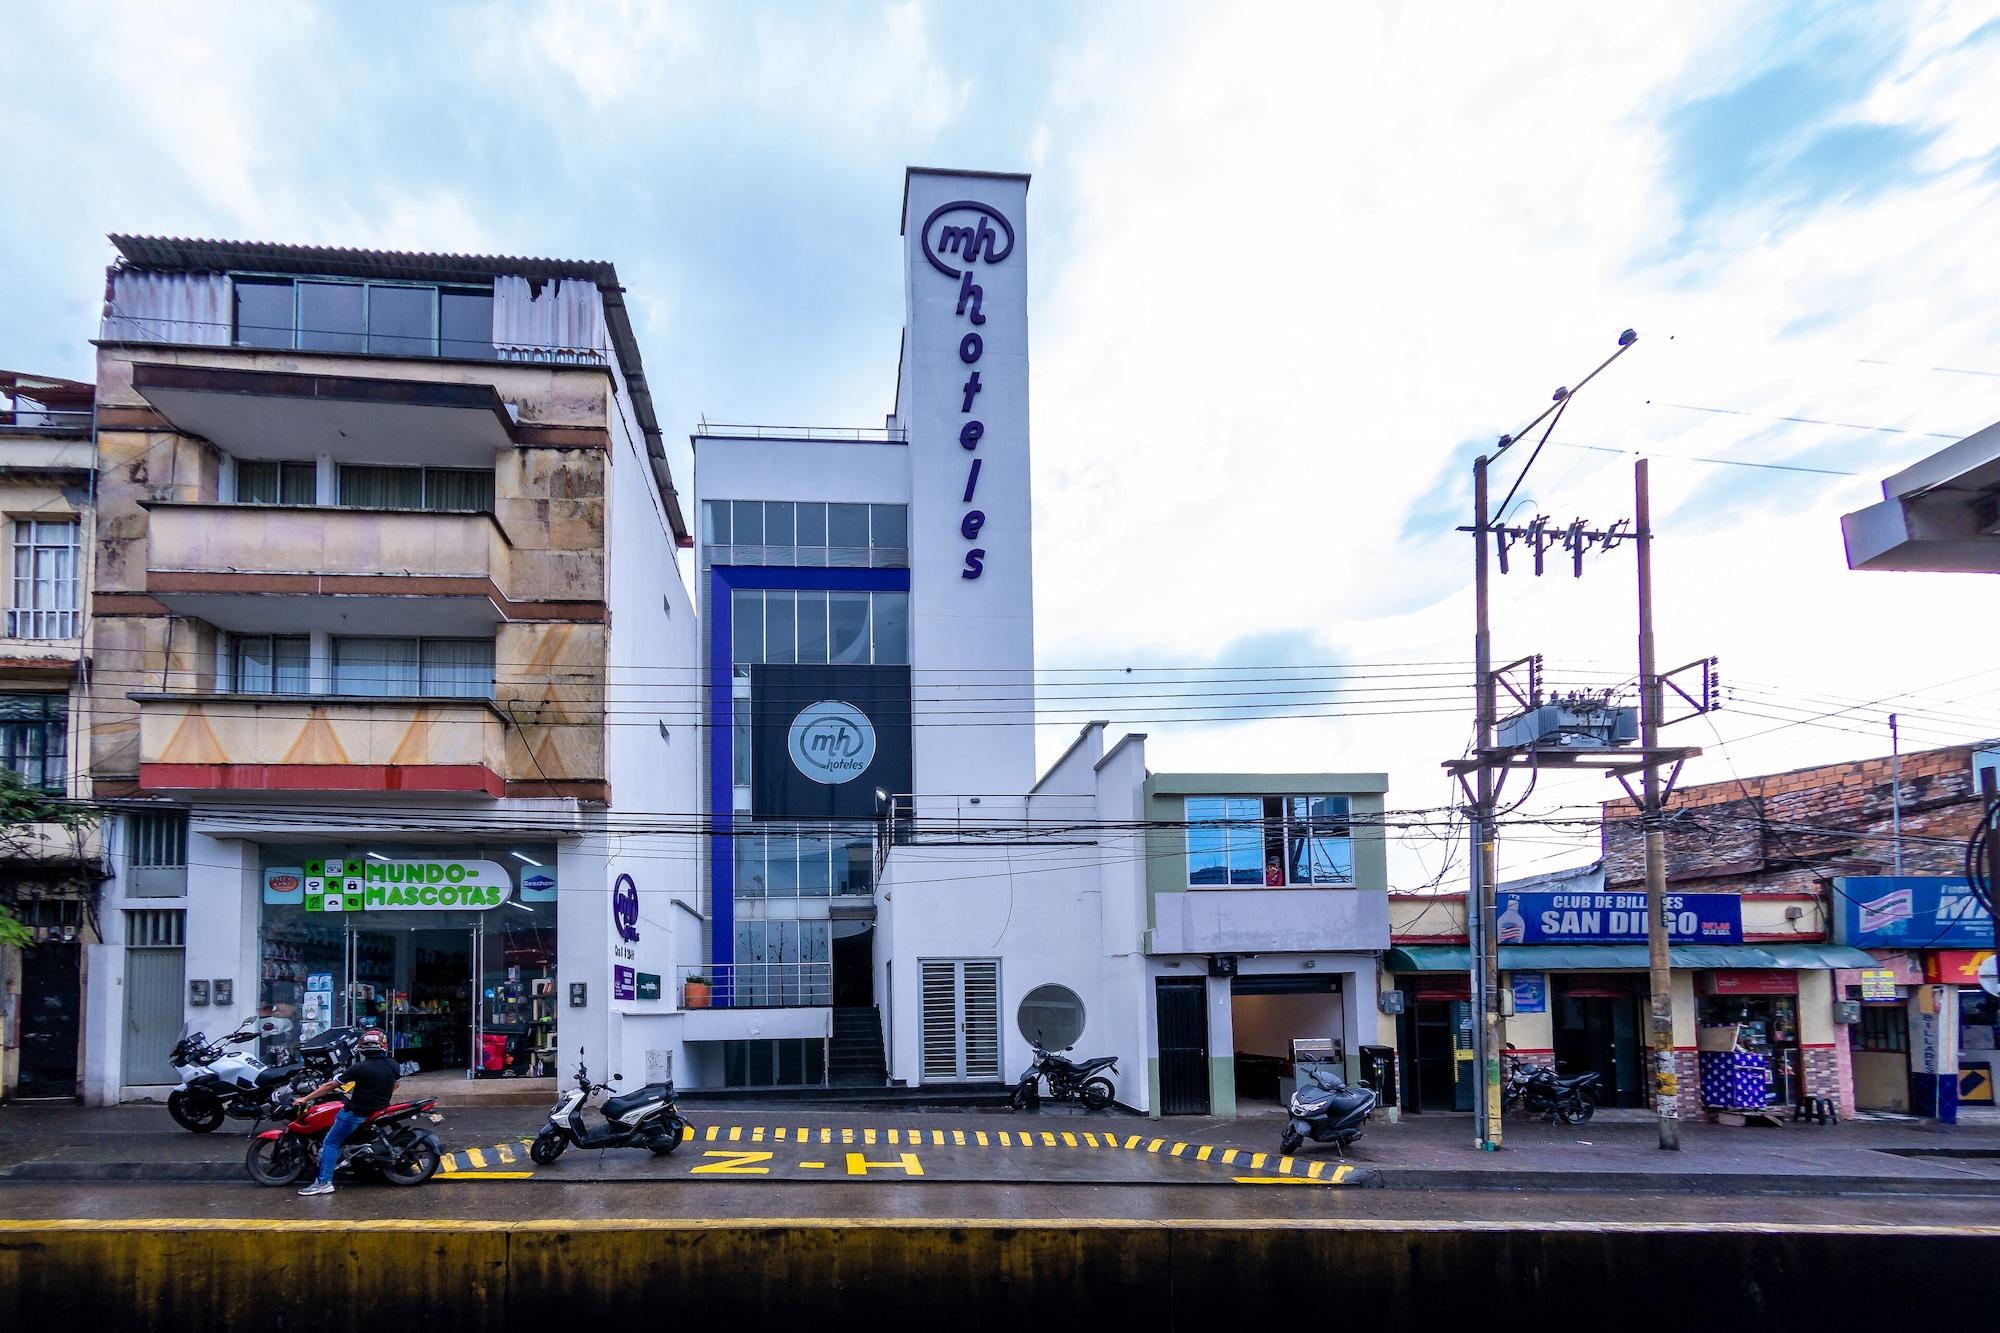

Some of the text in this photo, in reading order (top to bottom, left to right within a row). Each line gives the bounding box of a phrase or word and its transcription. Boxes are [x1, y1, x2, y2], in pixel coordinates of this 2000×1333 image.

[955, 271, 987, 580] hoteles
[826, 758, 864, 772] hoteles
[366, 886, 500, 905] MASCOTAS
[1553, 896, 1684, 909] CLUB DE BILLES
[1541, 911, 1601, 934] SAN
[1609, 911, 1698, 934] DIGO
